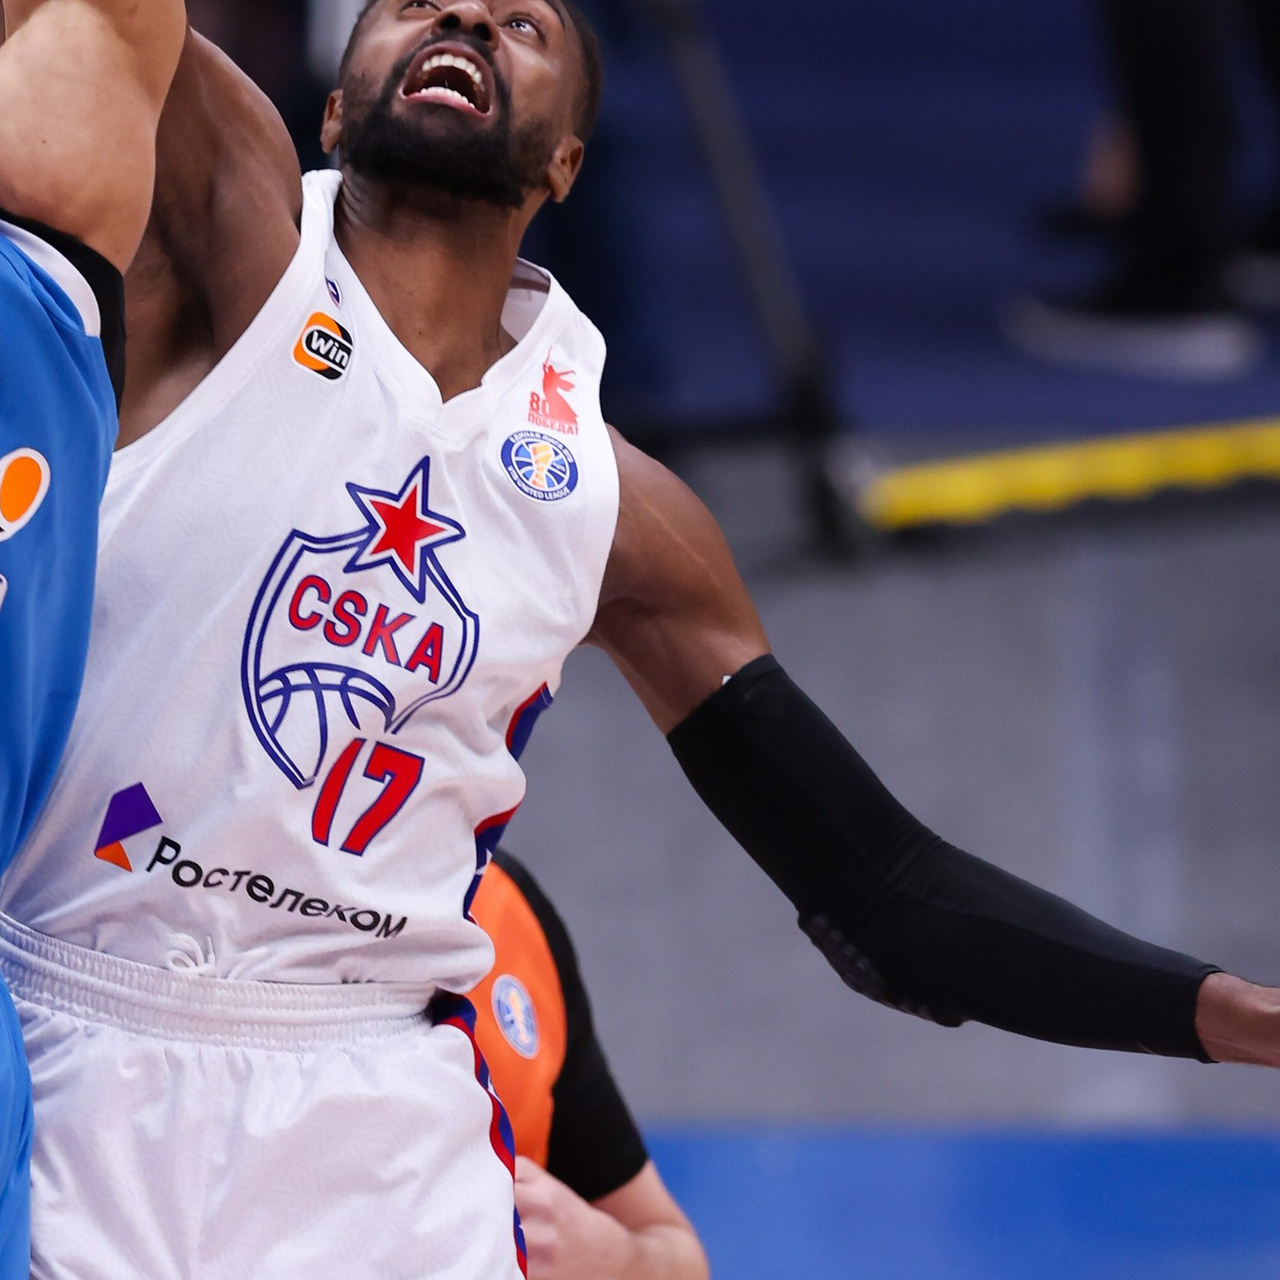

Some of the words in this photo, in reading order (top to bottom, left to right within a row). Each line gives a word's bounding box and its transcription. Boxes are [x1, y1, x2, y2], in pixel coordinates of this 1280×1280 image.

[311, 329, 349, 367] Win
[288, 574, 444, 685] CSKA
[311, 737, 425, 857] 17
[146, 835, 408, 939] Ростелеком
